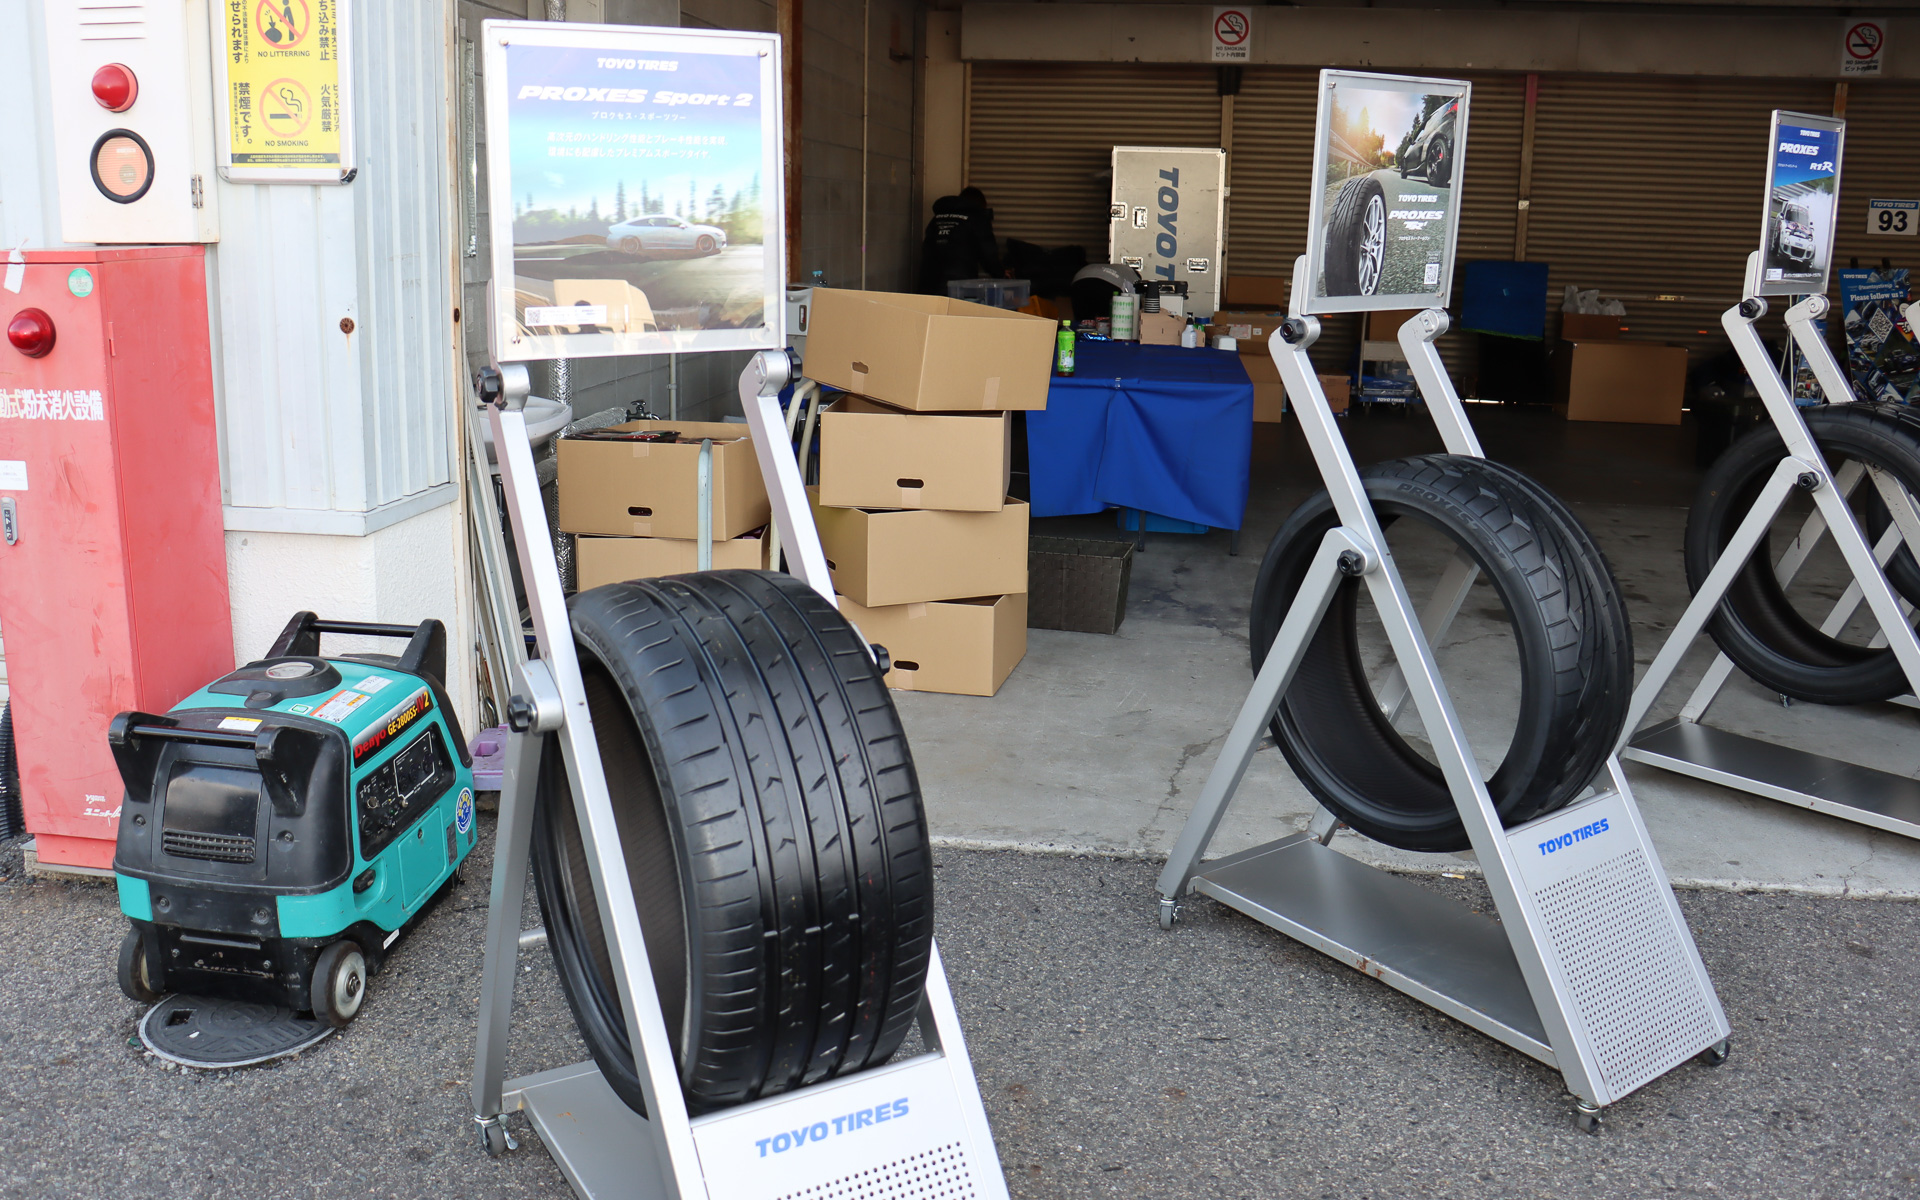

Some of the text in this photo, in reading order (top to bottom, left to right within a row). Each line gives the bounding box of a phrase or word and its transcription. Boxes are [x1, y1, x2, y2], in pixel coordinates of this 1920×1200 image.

[597, 57, 678, 72] TOYO TIRES
[321, 84, 332, 132] 火気厳禁
[517, 85, 754, 107] PROXES Sport 2
[238, 82, 253, 144] 禁煙です。
[1779, 142, 1820, 156] PROXES
[1810, 161, 1834, 173] R1R
[1398, 194, 1438, 203] TOYO TIRES
[1156, 167, 1179, 260] TOYO
[1388, 210, 1445, 220] PROXES
[1878, 210, 1908, 232] 93
[1850, 293, 1870, 302] Please
[1870, 292, 1890, 300] follow
[1396, 482, 1476, 526] PROXES
[387, 691, 430, 736] GE-2800SS-IV2
[354, 729, 387, 759] Denyo
[1538, 818, 1610, 856] TOYO TIRES
[755, 1097, 910, 1158] TOYO TIRES
